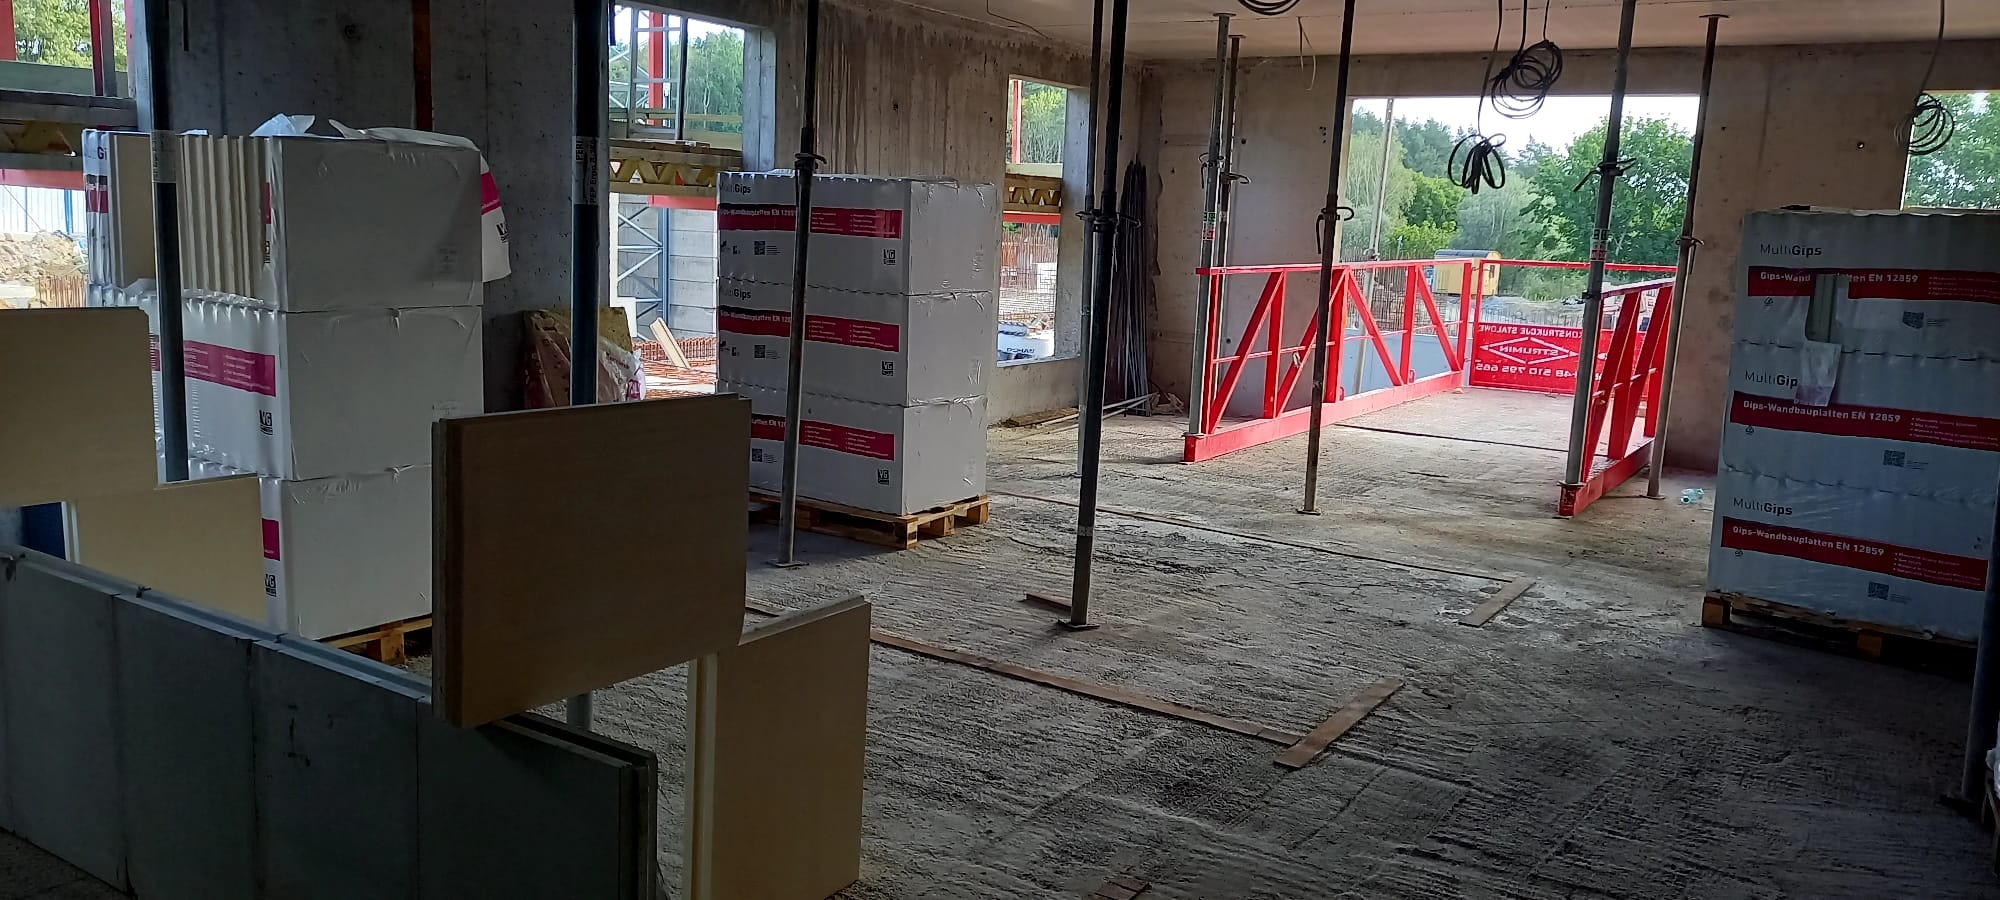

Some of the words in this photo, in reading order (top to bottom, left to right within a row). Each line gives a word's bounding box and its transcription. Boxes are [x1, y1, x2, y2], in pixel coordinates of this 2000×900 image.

[1760, 243, 1822, 258] MultiGips
[1868, 273, 1883, 282] EN
[1886, 273, 1919, 284] 12859
[1745, 370, 1798, 390] MultiGip
[1743, 400, 1849, 419] Gips-Wandbauplatten
[1851, 411, 1866, 420] EN
[1870, 412, 1901, 423] 12859
[1733, 497, 1793, 517] MultiGips
[1732, 525, 1834, 549] Gips-Wandbauplatten
[1835, 541, 1850, 551] EN
[1853, 543, 1885, 556] 12859
